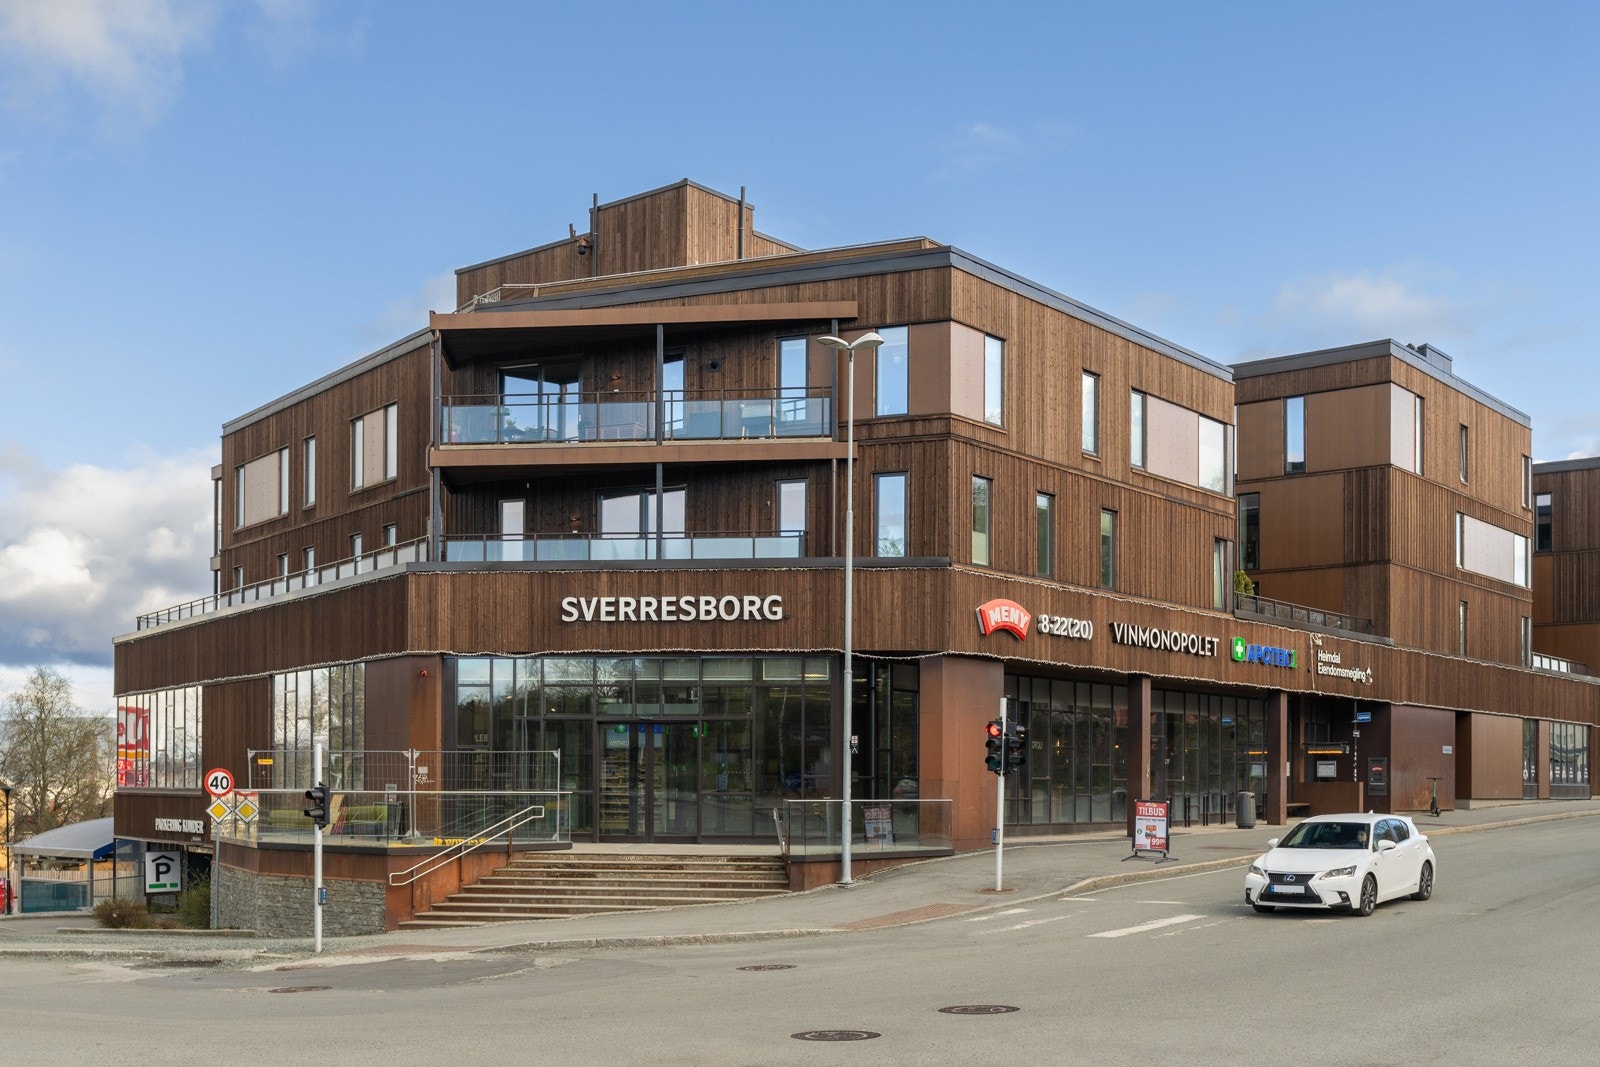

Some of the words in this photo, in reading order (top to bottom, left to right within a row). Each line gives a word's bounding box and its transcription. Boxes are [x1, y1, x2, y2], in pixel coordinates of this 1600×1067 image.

[561, 595, 783, 622] SVERRESBORG
[989, 606, 1028, 628] MENY
[1039, 614, 1093, 640] 8-22(20)
[1114, 622, 1219, 657] VINMONOPOLET
[1317, 650, 1340, 664] Heimdal
[1317, 663, 1366, 682] Eiendomsmegling
[210, 776, 229, 789] 40
[1139, 806, 1164, 816] TILBUD
[156, 862, 171, 882] P
